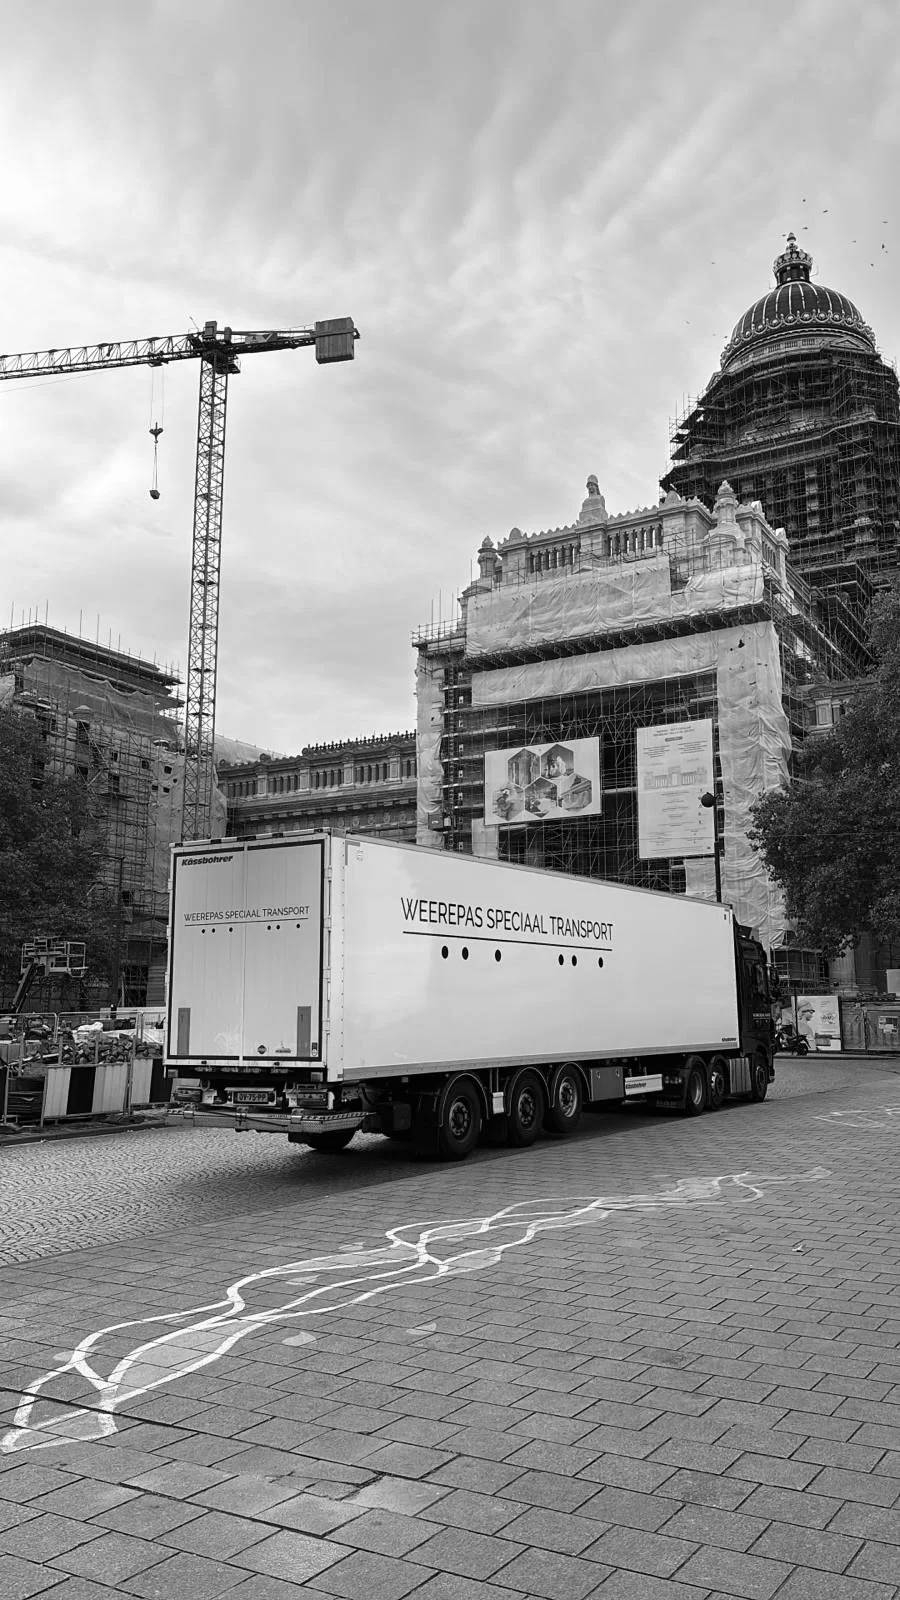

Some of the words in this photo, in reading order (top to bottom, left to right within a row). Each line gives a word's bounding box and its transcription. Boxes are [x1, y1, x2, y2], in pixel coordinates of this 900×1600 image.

[183, 911, 224, 922] WEEREPAS
[225, 908, 261, 920] SPECIAAL
[262, 905, 310, 917] TRANSPORT
[400, 896, 483, 928] WEEREPAS
[486, 908, 548, 935] SPECIAAL
[549, 915, 614, 941] TRANSPORT
